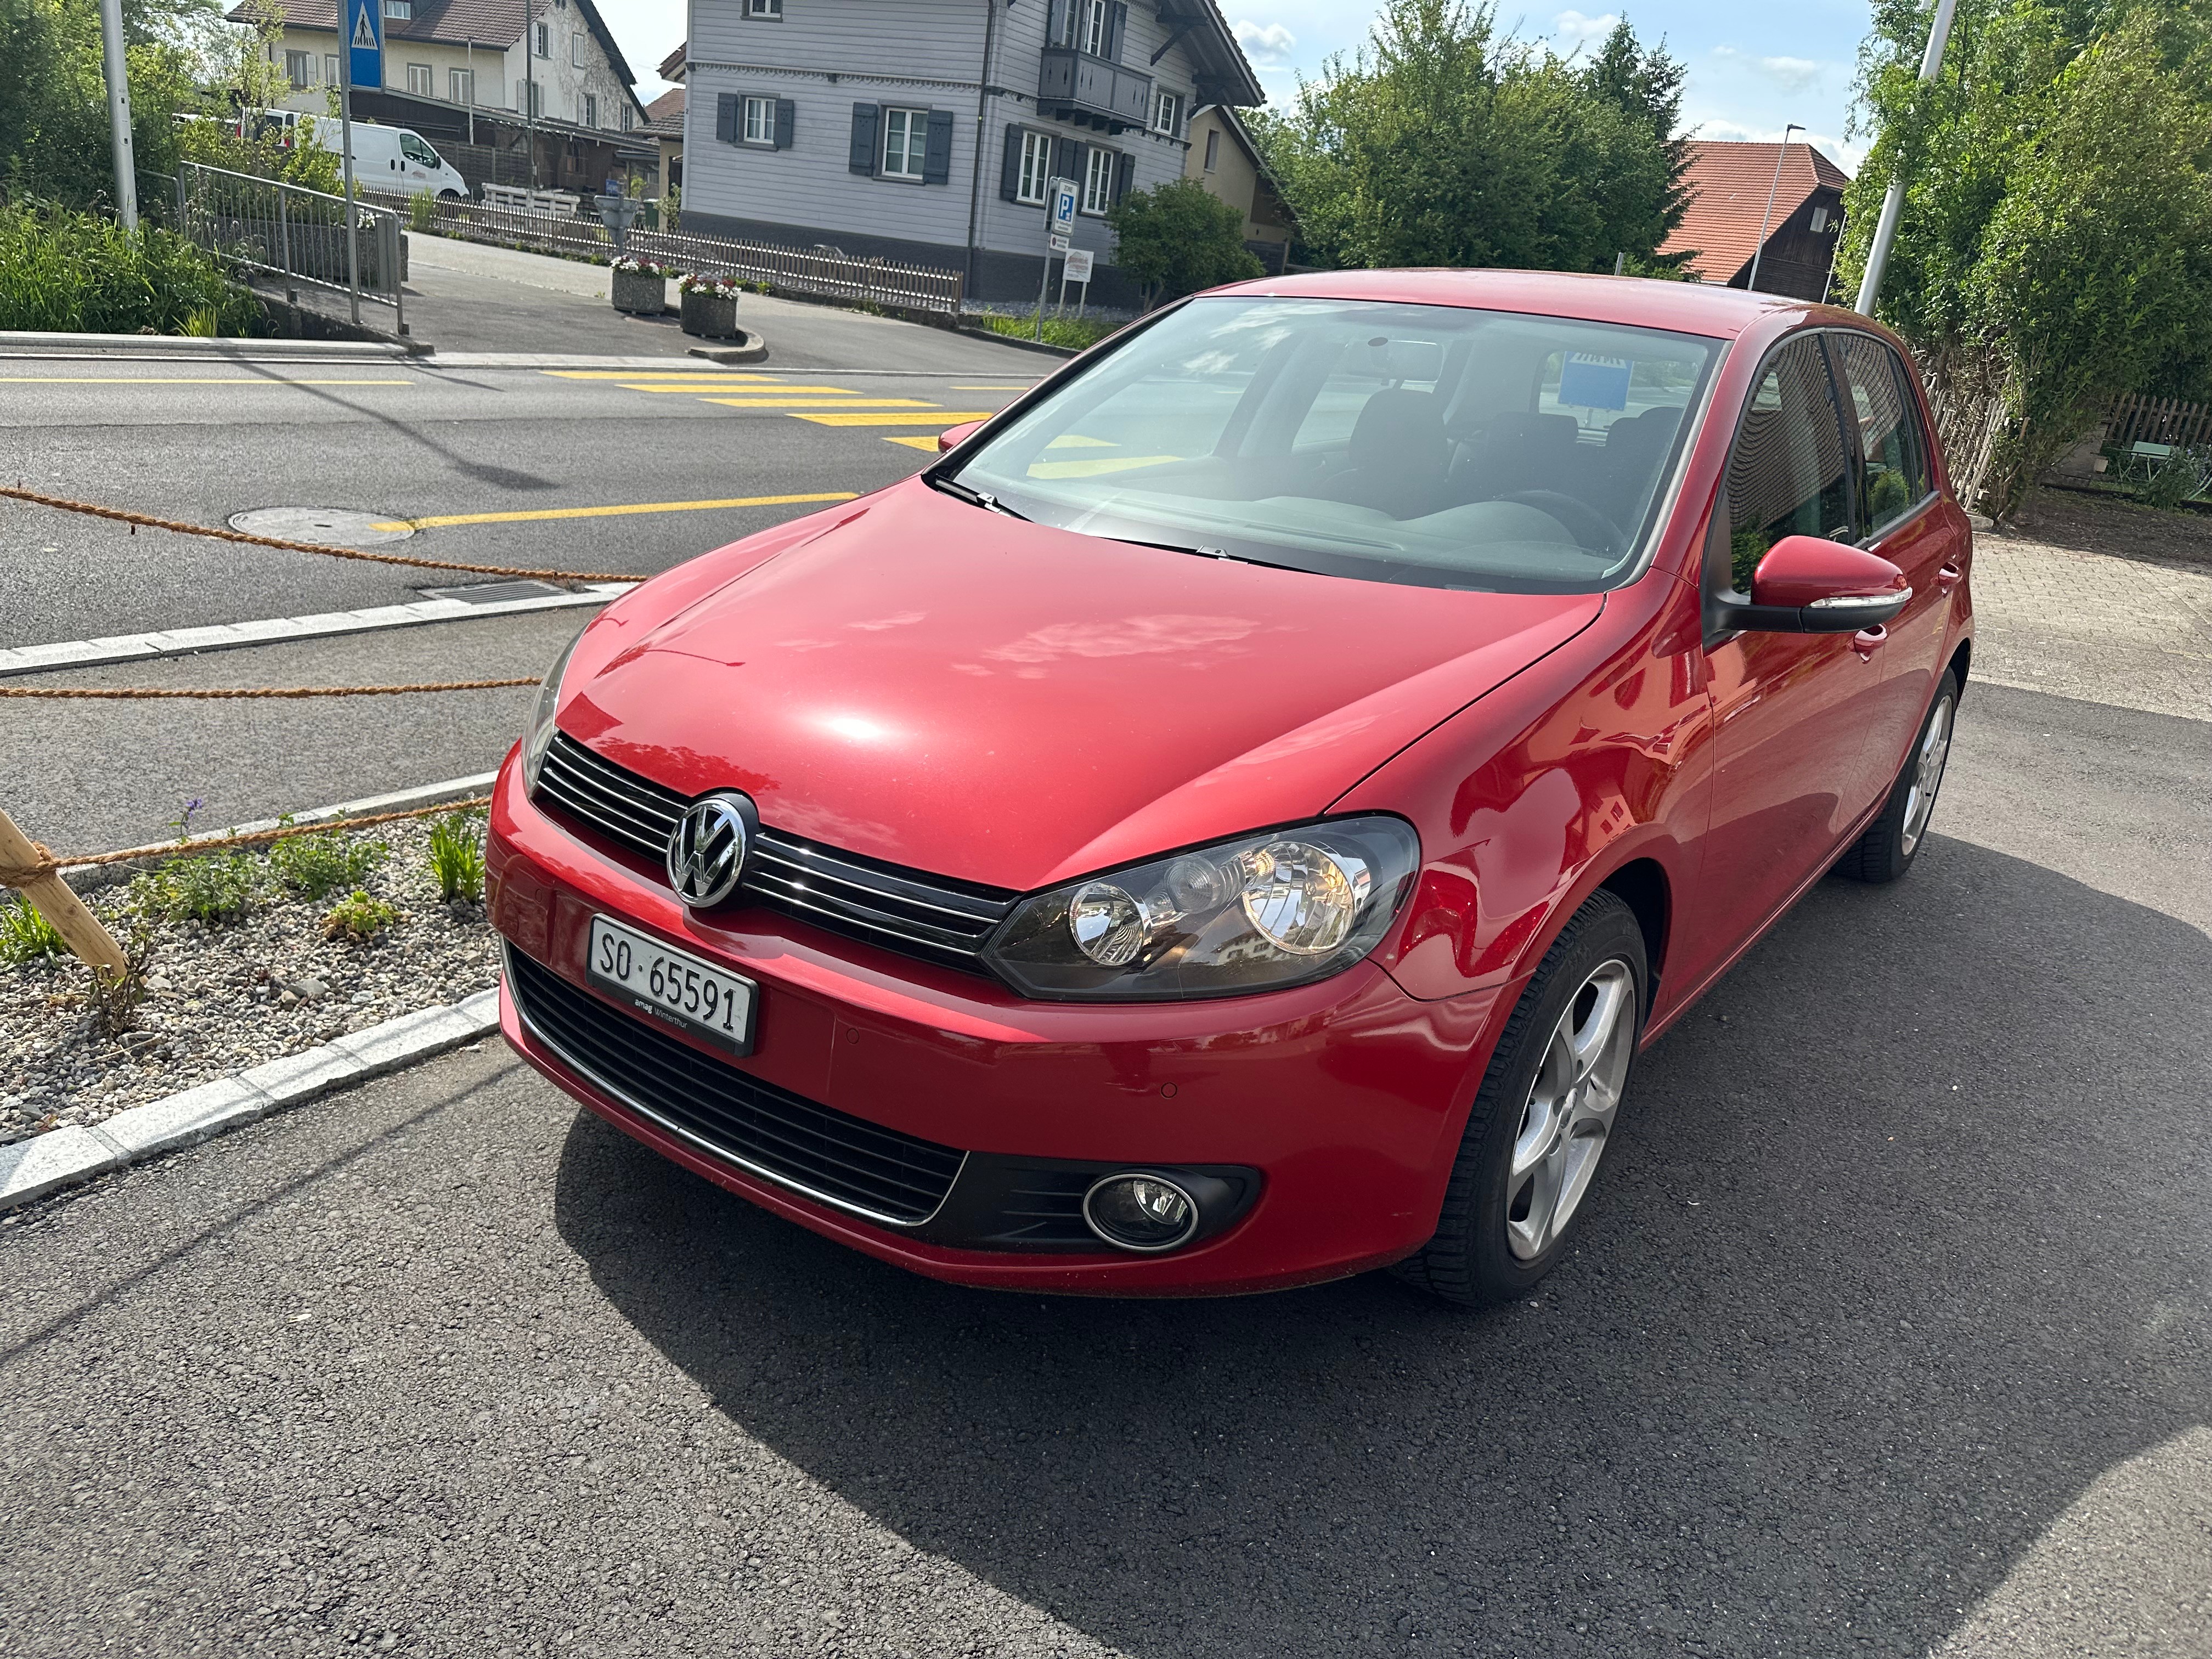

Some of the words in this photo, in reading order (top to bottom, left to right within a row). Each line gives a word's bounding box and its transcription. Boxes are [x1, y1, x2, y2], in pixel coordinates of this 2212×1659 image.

[1060, 195, 1070, 217] P
[635, 998, 653, 1014] amag
[654, 1007, 687, 1029] Winterthur
